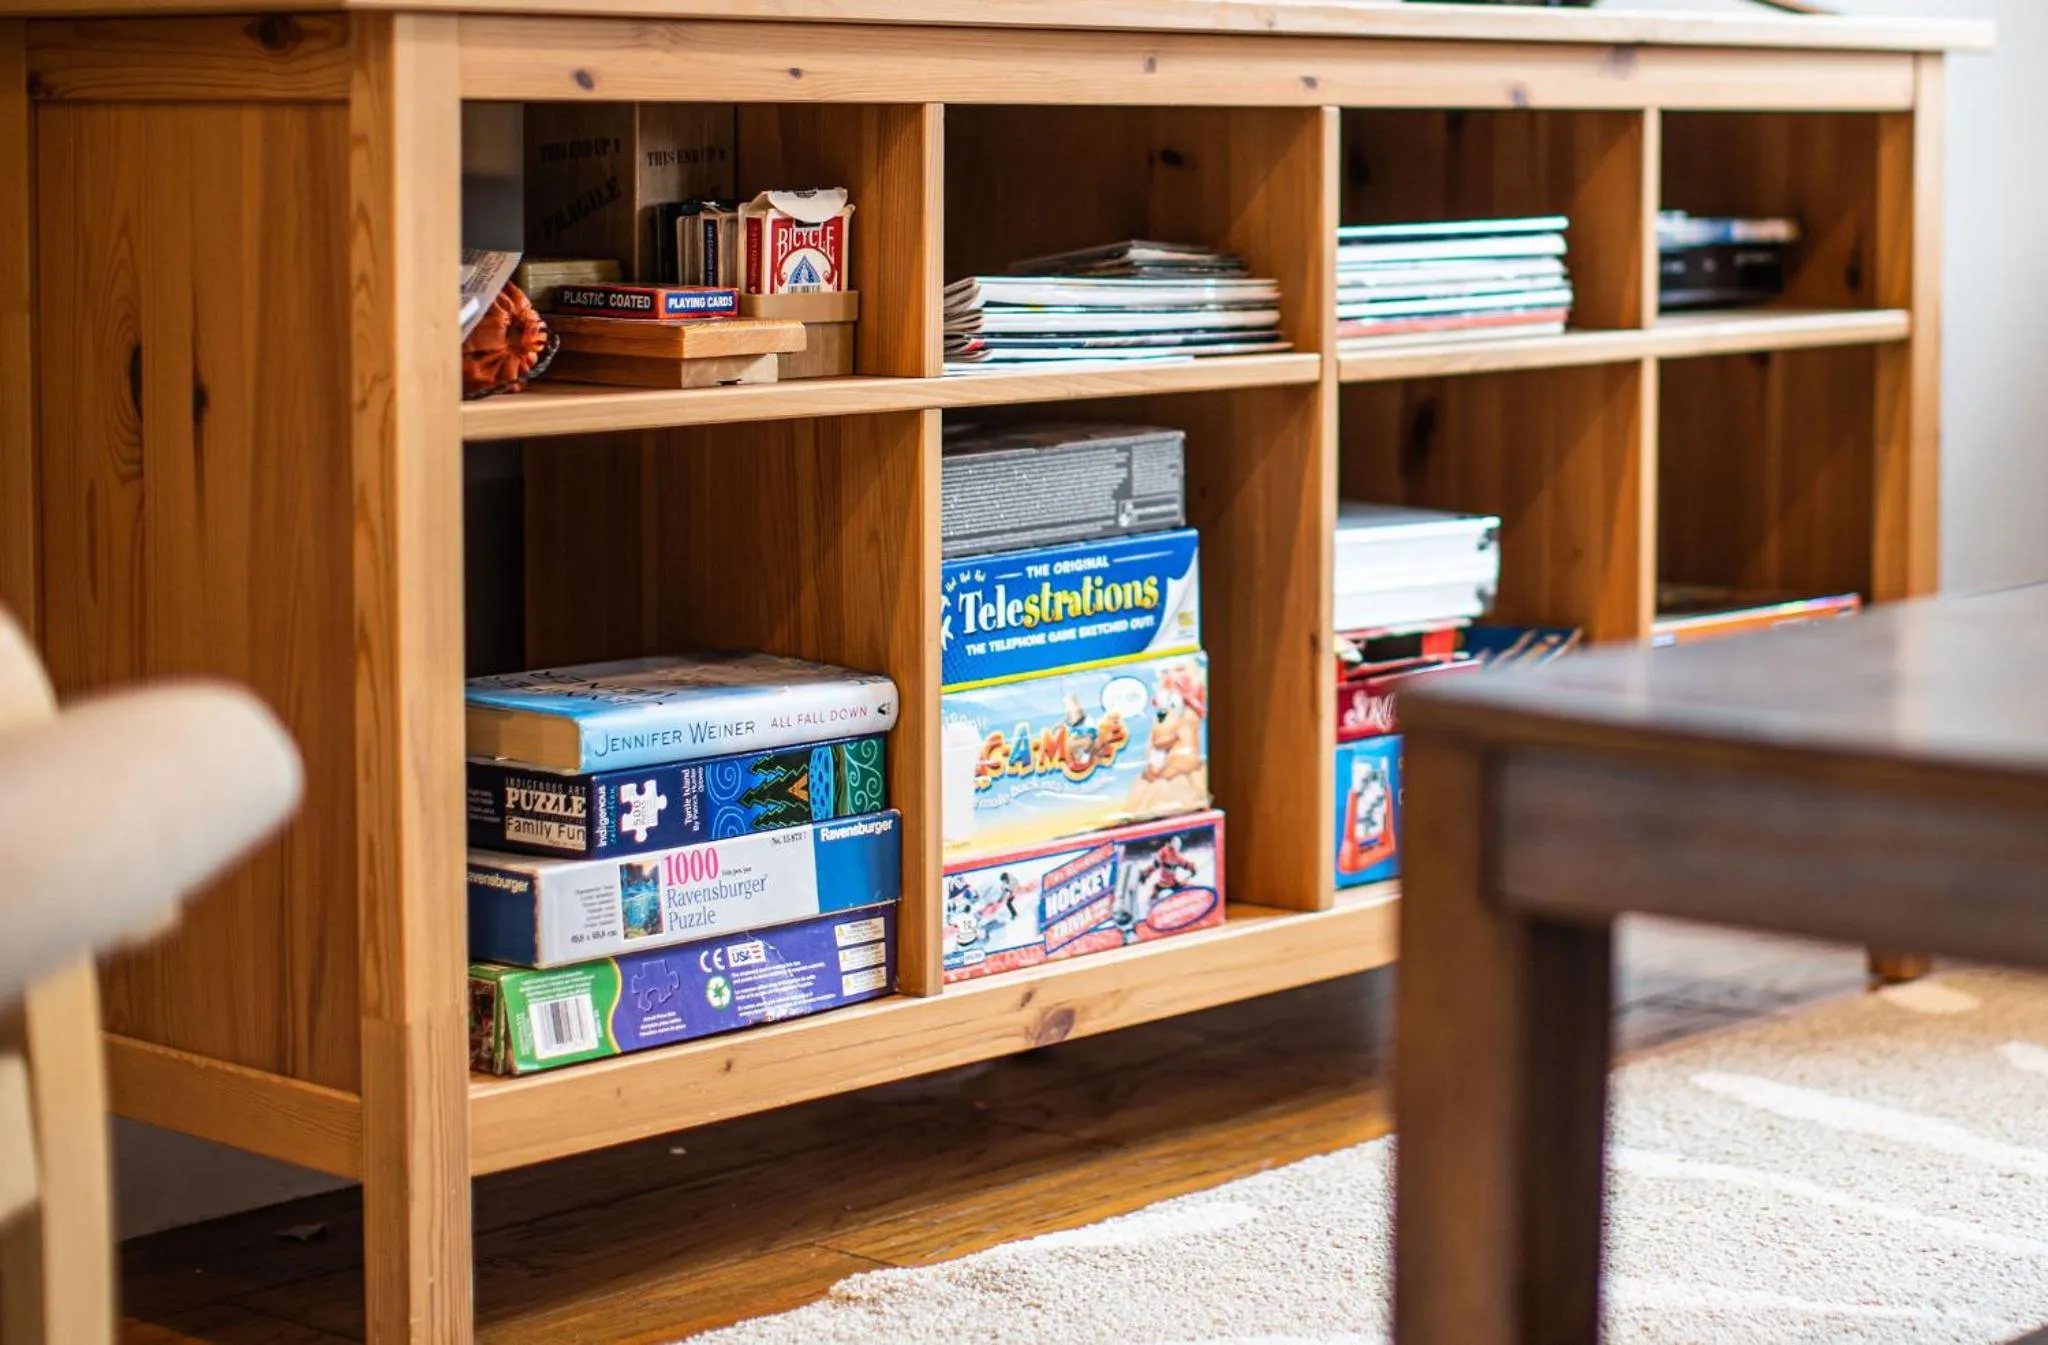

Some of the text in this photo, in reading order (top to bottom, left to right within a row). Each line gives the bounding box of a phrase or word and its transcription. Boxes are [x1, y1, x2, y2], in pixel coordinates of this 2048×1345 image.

[647, 150, 676, 167] THIS
[777, 225, 835, 267] BICYCLE
[563, 290, 651, 310] PLASTIC COATED
[668, 295, 733, 310] PLAYING CARDS
[1026, 555, 1109, 579] THE ORIGINAL
[958, 575, 1160, 635] Telestrations
[965, 642, 987, 656] THE
[988, 633, 1047, 653] TELEPHONE
[1048, 627, 1077, 643] GAME
[1079, 619, 1128, 638] SKETCHED
[595, 706, 868, 757] JENNIFER WEINER ALL FALL DOWN
[505, 787, 587, 818] PUZZLE
[681, 768, 693, 827] Turtle Island
[506, 817, 553, 839] Family
[557, 824, 586, 843] Fun
[691, 820, 700, 832] By
[820, 818, 893, 842] Ravensburger
[664, 847, 720, 887] 1000
[468, 871, 530, 893] avensburger
[666, 875, 766, 909] Ravensburger
[1044, 863, 1113, 917] HOCKEY
[668, 908, 717, 932] Puzzle
[732, 949, 752, 964] USA
